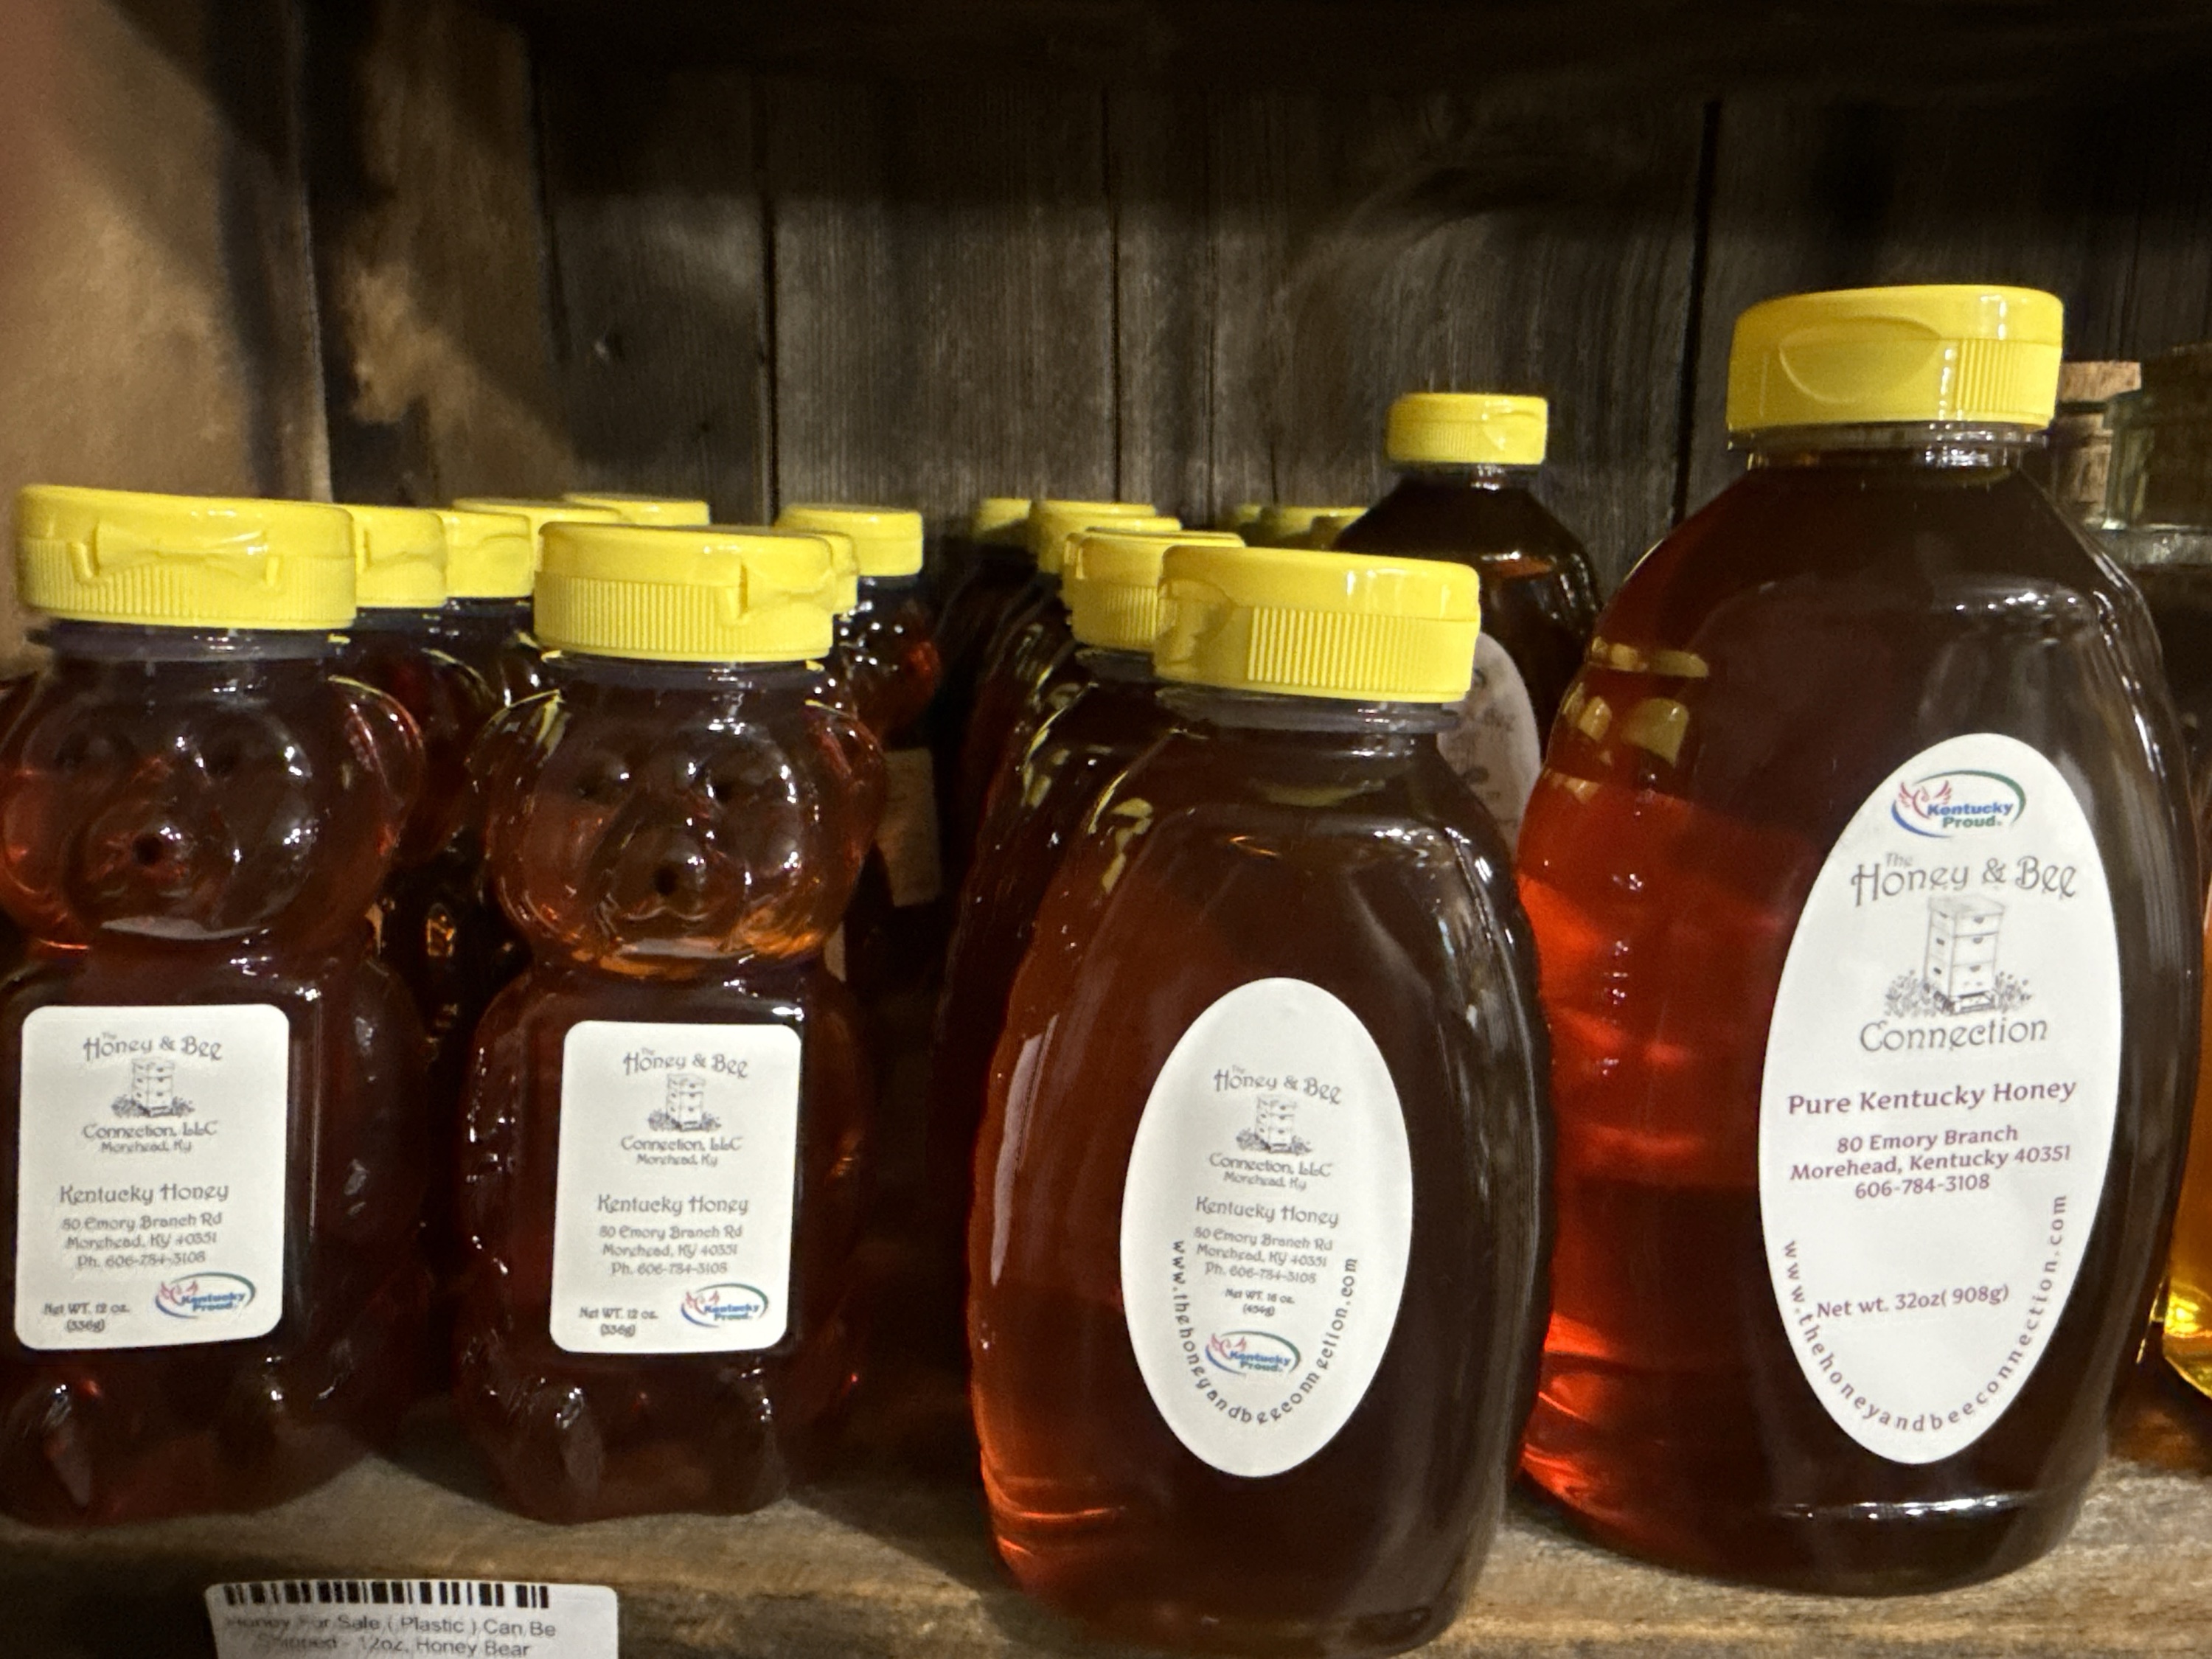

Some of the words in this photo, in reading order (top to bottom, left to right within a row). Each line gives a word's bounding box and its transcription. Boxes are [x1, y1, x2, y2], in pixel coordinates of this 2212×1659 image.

[1927, 802, 2014, 815] Kentucky
[1885, 852, 1913, 868] The
[1851, 863, 1969, 907] Honey
[1982, 858, 2006, 884] &
[2015, 855, 2076, 899] Bee
[1860, 1018, 2048, 1051] Connection
[83, 1037, 153, 1061] Honey
[160, 1036, 175, 1051] &
[181, 1035, 222, 1061] Bee
[623, 1052, 686, 1076] Honey
[692, 1053, 706, 1068] &
[712, 1054, 748, 1078] Bee
[1214, 1069, 1277, 1092] Honey
[1283, 1075, 1298, 1091] &
[1304, 1077, 1342, 1105] Bee
[1787, 1093, 1851, 1115] Pure
[1860, 1085, 1985, 1113] Kentucky
[1993, 1080, 2076, 1103] Honey
[183, 1121, 218, 1136] LLC
[1837, 1136, 1863, 1154] 80
[1870, 1132, 1938, 1152] Emory
[1944, 1124, 2018, 1145] Branch
[710, 1136, 743, 1151] LLC
[1298, 1161, 1333, 1177] LLC
[1790, 1156, 1902, 1180] Morehead,
[1910, 1149, 2008, 1171] Kentucky
[2014, 1145, 2070, 1164] 40351
[60, 1185, 154, 1205] Kentucky
[160, 1183, 229, 1201] Honey
[1855, 1172, 1991, 1200] 606-784-3108
[597, 1194, 683, 1216] Kentucky
[689, 1194, 749, 1215] Honey
[1195, 1196, 1276, 1222] Kentucky
[1281, 1205, 1339, 1228] Honey
[84, 1217, 136, 1232] Emory
[140, 1214, 197, 1230] Branch
[200, 1212, 223, 1227] Rd
[619, 1225, 665, 1240] Emory
[669, 1225, 720, 1239] Branch
[723, 1224, 743, 1238] Rd
[1213, 1228, 1257, 1246] Emory
[1260, 1233, 1311, 1249] Branch
[1315, 1238, 1333, 1251] Rd
[77, 1254, 100, 1267] Ph.
[611, 1262, 633, 1275] Ph.
[1205, 1262, 1226, 1276] Ph.
[182, 1292, 246, 1305] Kentucky
[703, 1304, 759, 1313] Kentucky
[1816, 1301, 1851, 1318] Net
[1858, 1297, 1889, 1314] wt.
[627, 1308, 639, 1319] 12
[1784, 1195, 2067, 1431] www.thehoneyandbeeconnection.com
[1172, 1239, 1358, 1425] www.thehoneyandbeeconnection.com
[1230, 1350, 1291, 1366] Kentucky
[338, 1614, 380, 1630] Sale
[401, 1616, 465, 1632] Plastic
[484, 1618, 522, 1635] Can
[530, 1621, 557, 1637] Be
[417, 1638, 477, 1658] Honey
[485, 1640, 532, 1657] Bear
